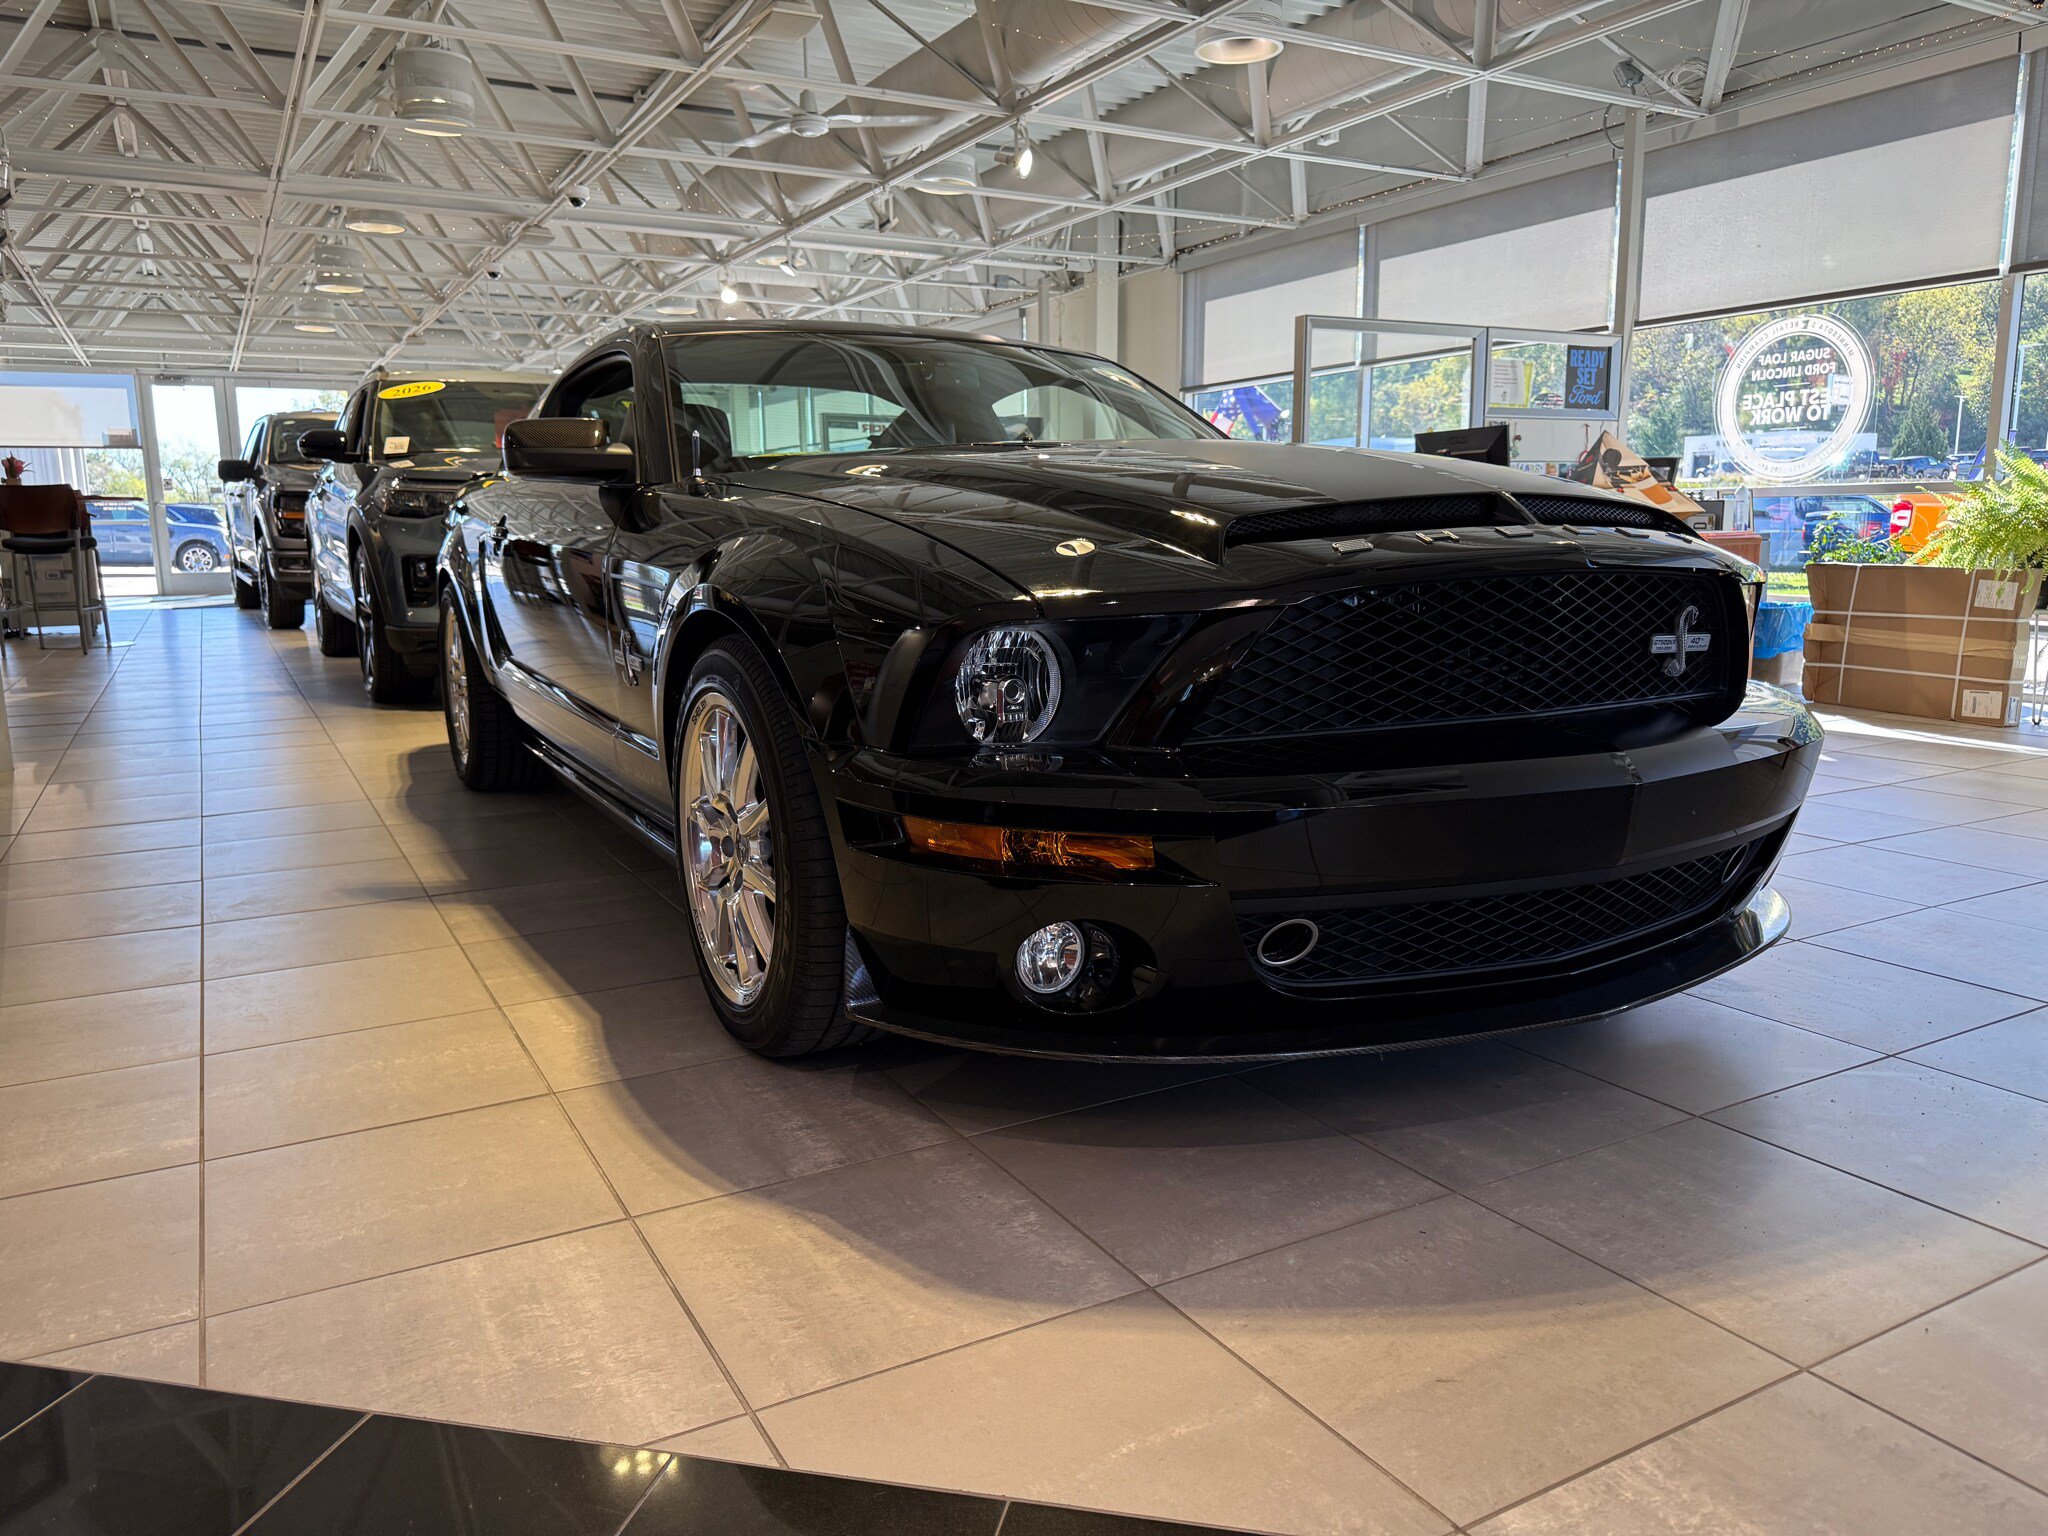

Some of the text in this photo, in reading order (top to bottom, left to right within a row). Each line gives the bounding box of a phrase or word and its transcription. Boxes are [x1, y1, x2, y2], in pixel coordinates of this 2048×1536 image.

[1570, 349, 1606, 369] READY
[1577, 367, 1597, 385] SET
[392, 385, 431, 396] 2026
[1569, 384, 1604, 405] Ford
[691, 699, 708, 726] SHELBY
